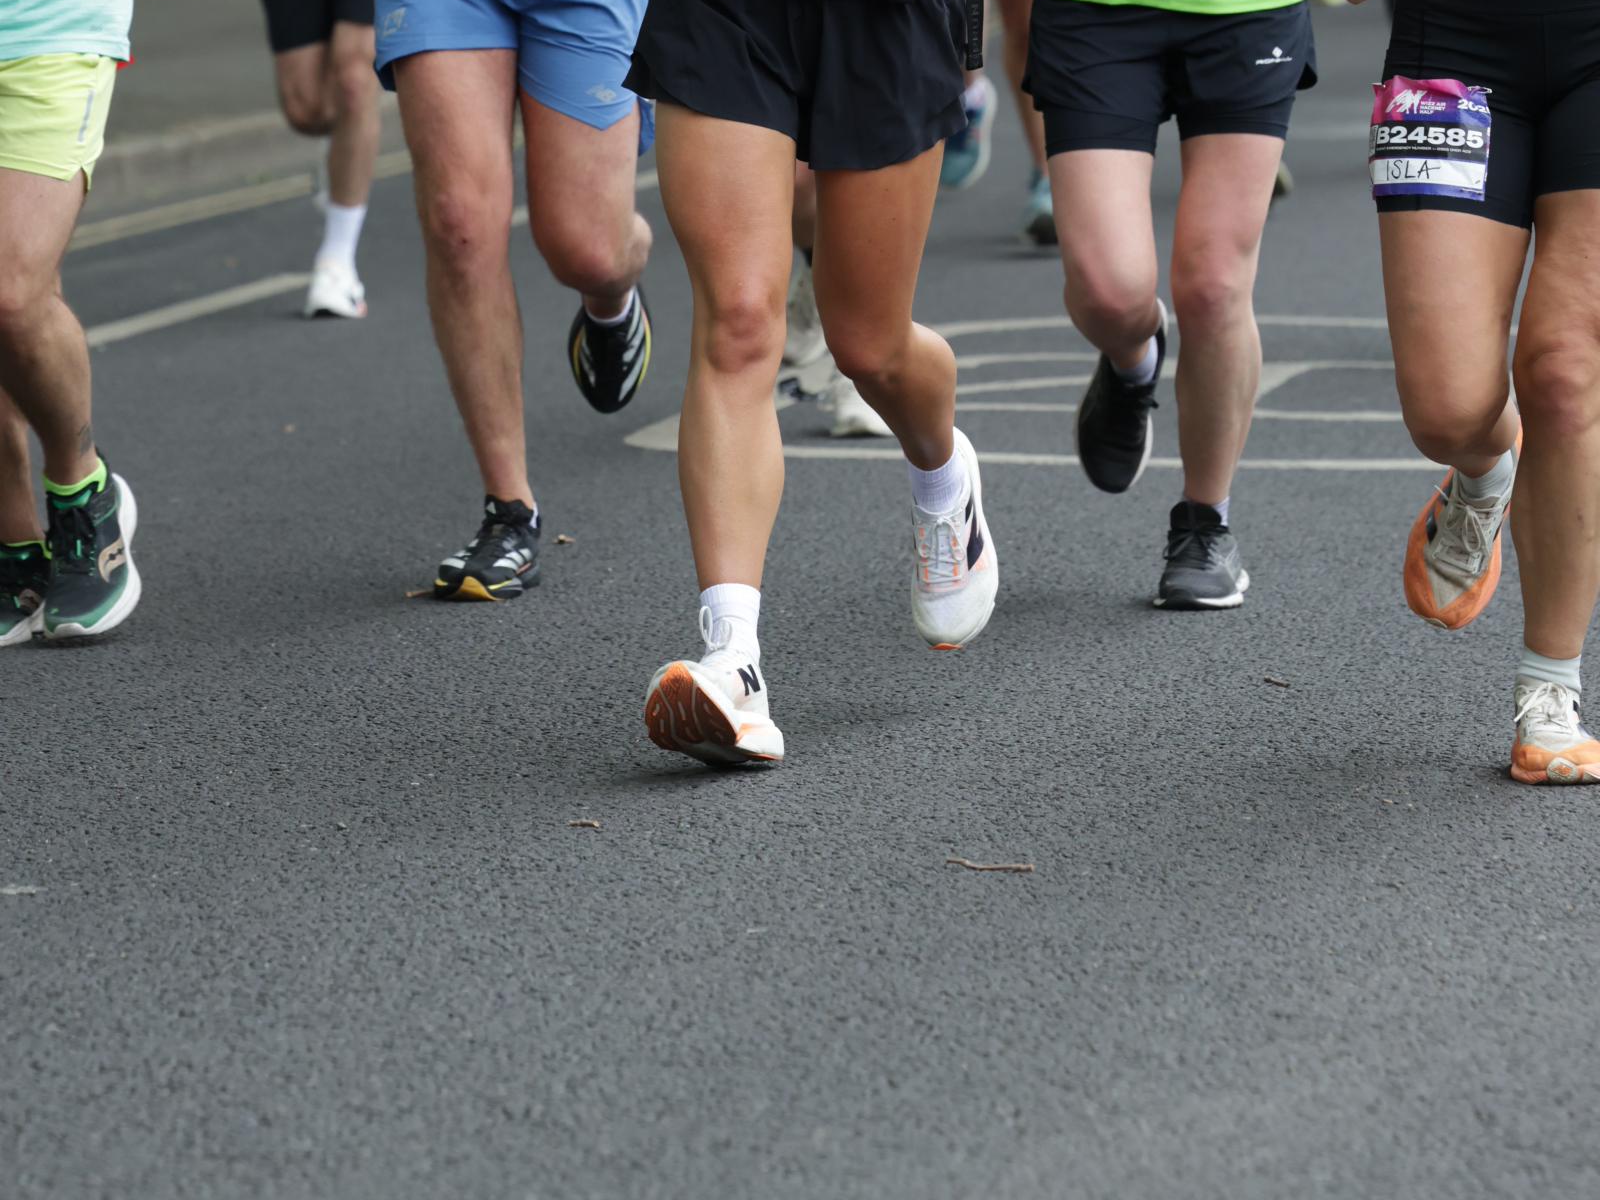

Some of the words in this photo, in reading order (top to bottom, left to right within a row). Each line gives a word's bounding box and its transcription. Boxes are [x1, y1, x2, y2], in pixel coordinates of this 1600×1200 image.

[1377, 126, 1484, 148] B24585
[1386, 159, 1440, 180] ISLA
[737, 664, 761, 696] N
